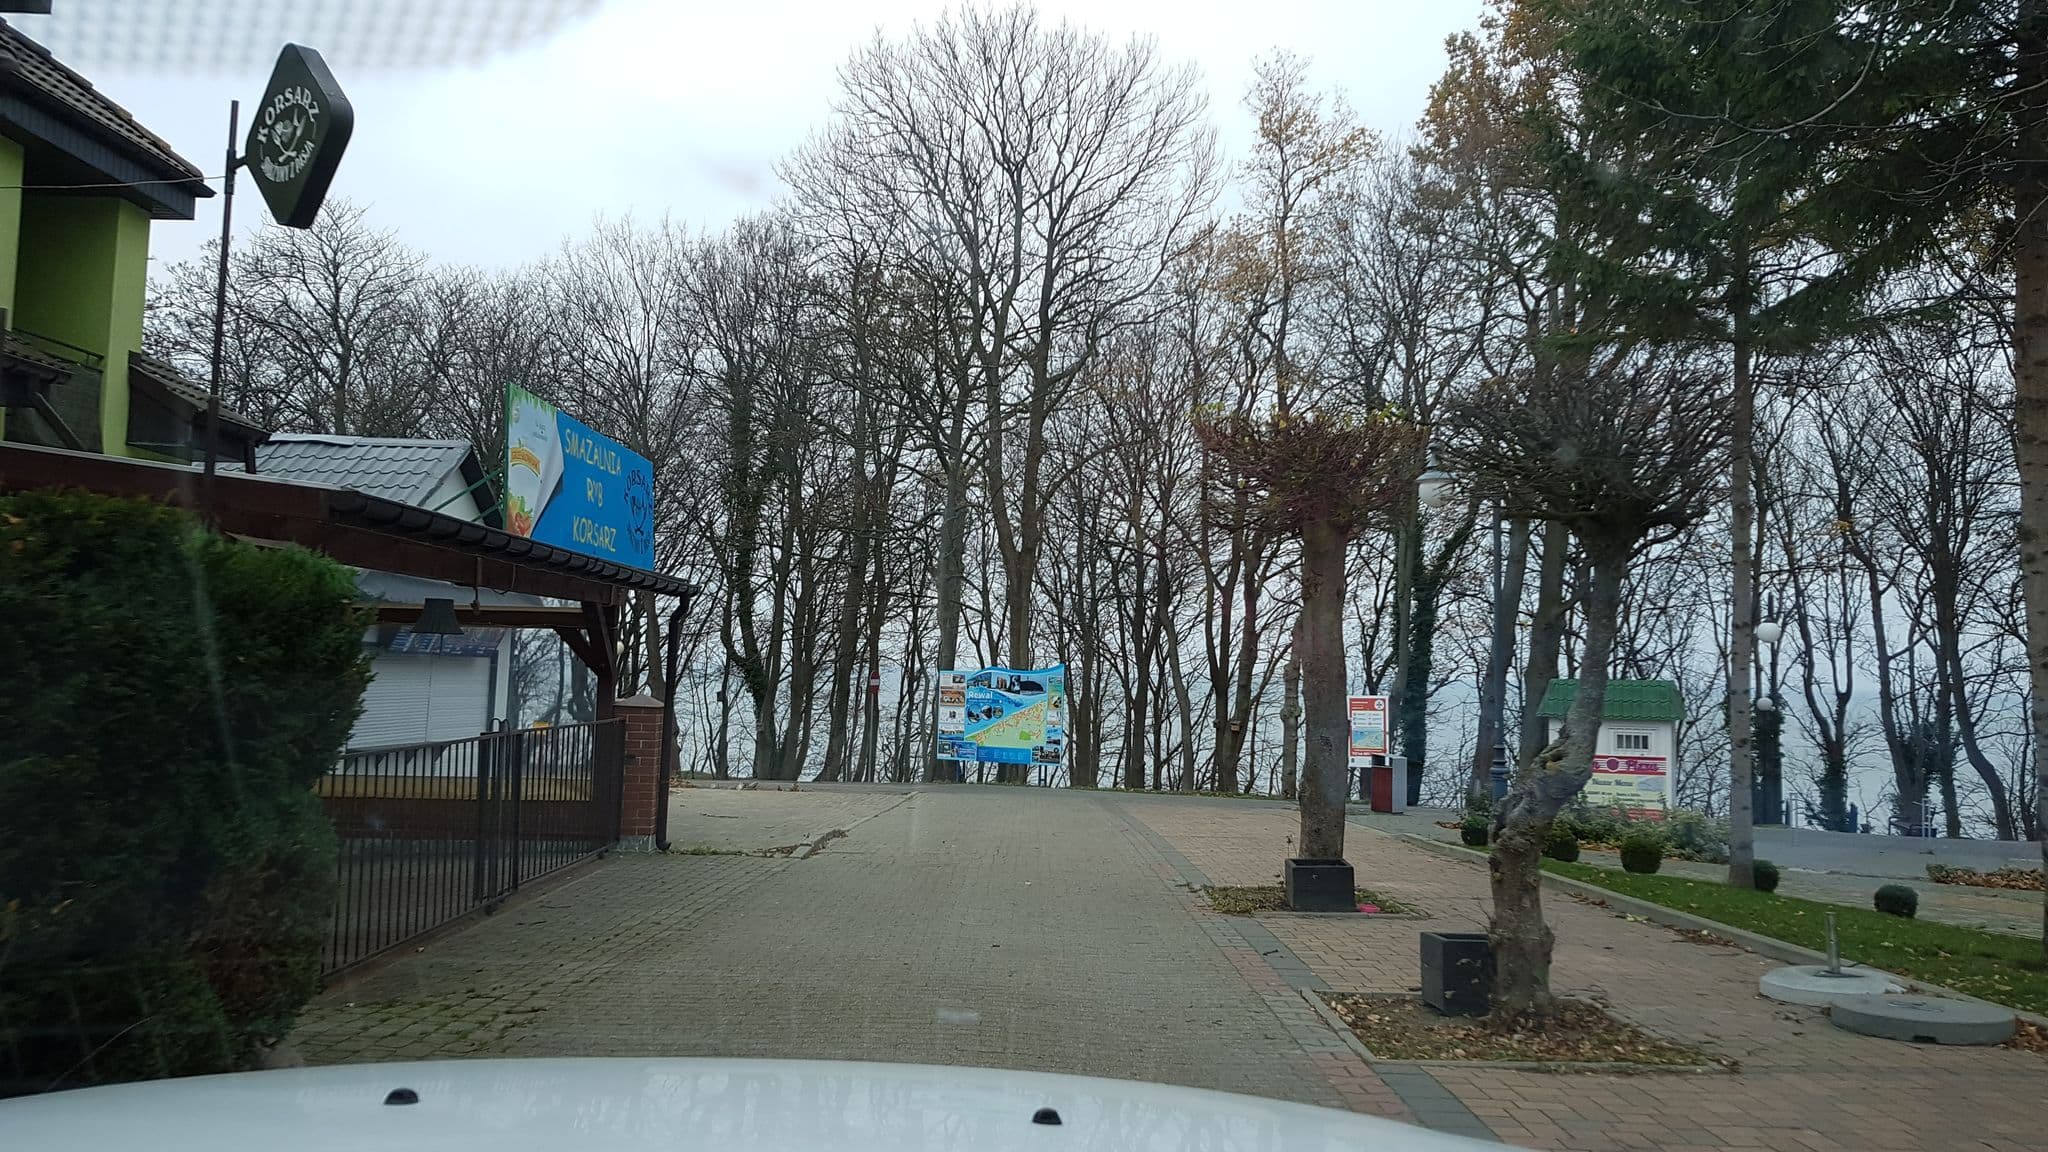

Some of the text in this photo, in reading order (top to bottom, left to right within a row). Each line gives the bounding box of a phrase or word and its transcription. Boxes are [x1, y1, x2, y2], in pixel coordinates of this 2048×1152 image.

[257, 86, 320, 143] KORSARZ
[586, 477, 604, 507] RYB
[572, 515, 617, 552] KORSARZ
[968, 690, 993, 699] Rewal
